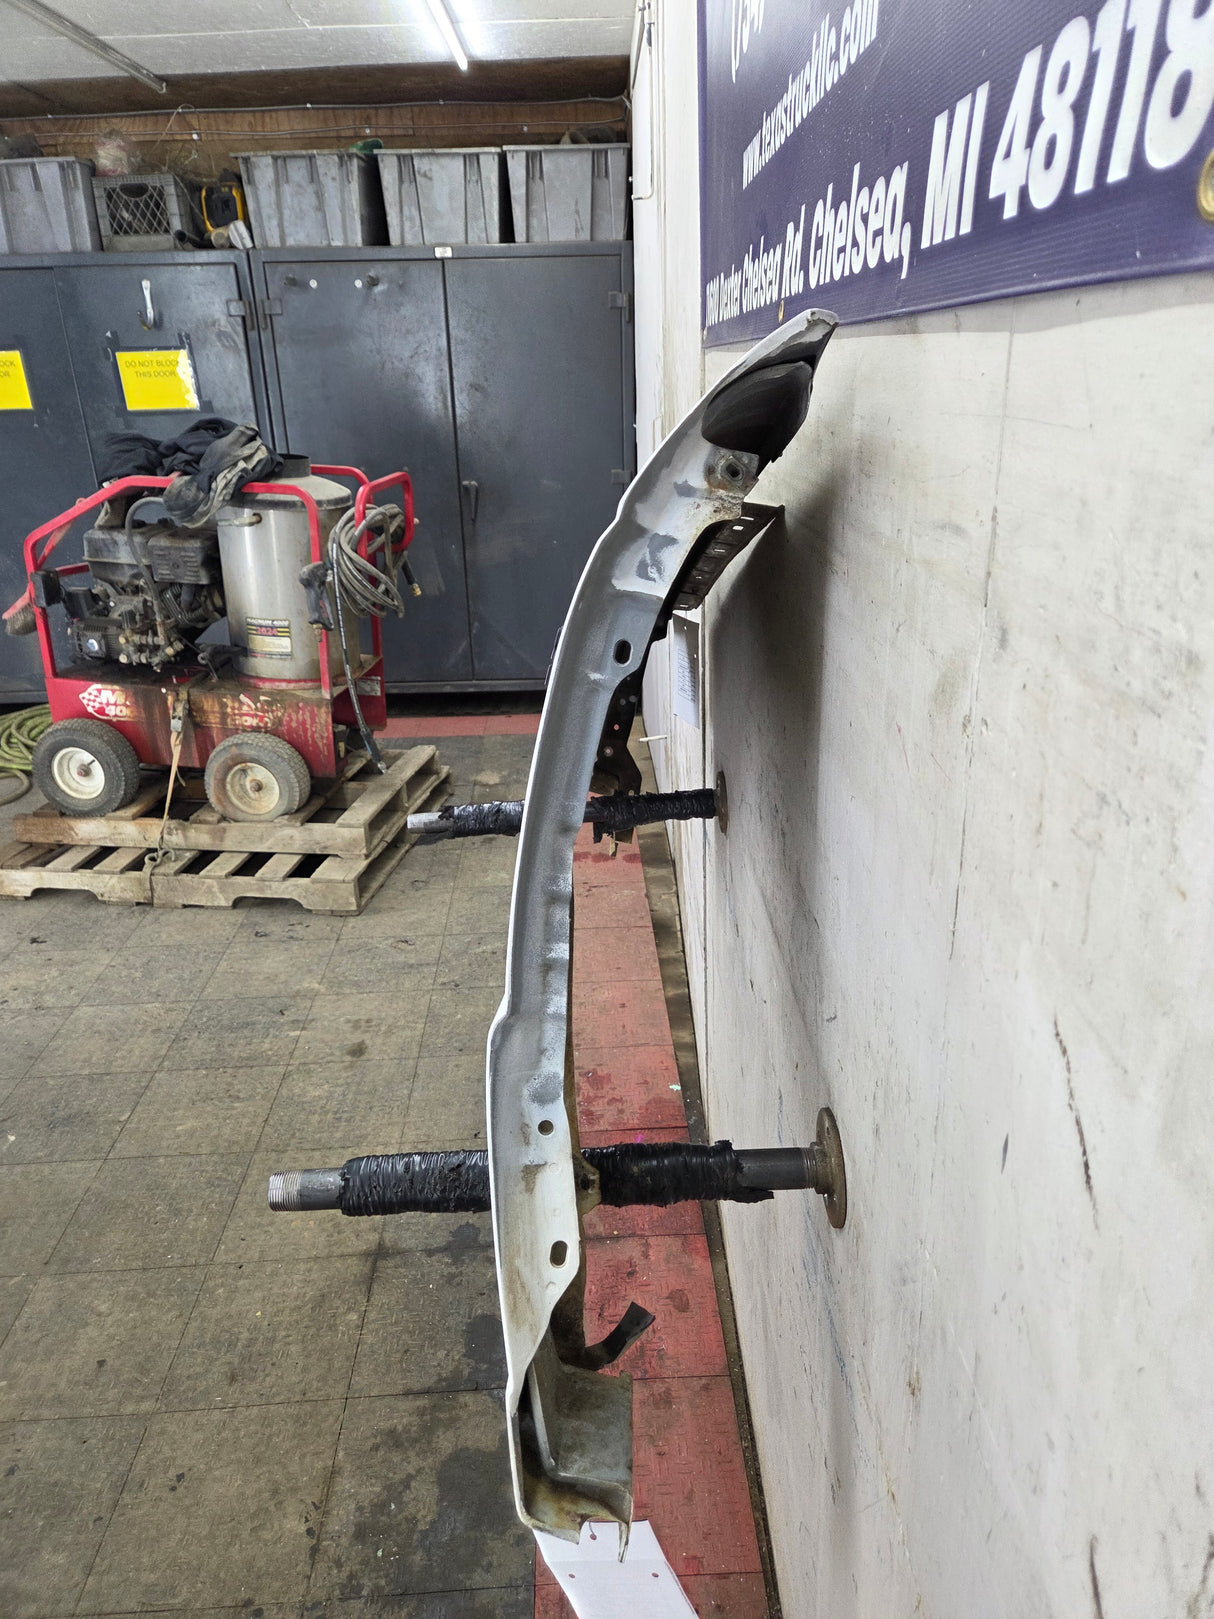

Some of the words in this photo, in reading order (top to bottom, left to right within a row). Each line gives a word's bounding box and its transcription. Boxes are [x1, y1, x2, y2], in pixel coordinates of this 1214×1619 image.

[719, 264, 742, 322] Dexter
[742, 244, 783, 314] Chelsea
[781, 203, 806, 299] Rd.
[809, 160, 911, 290] Chelsea,
[920, 80, 990, 249] MI
[989, 0, 1214, 220] 48118
[743, 0, 880, 191] www.texastruckllc.com
[124, 360, 136, 368] DO
